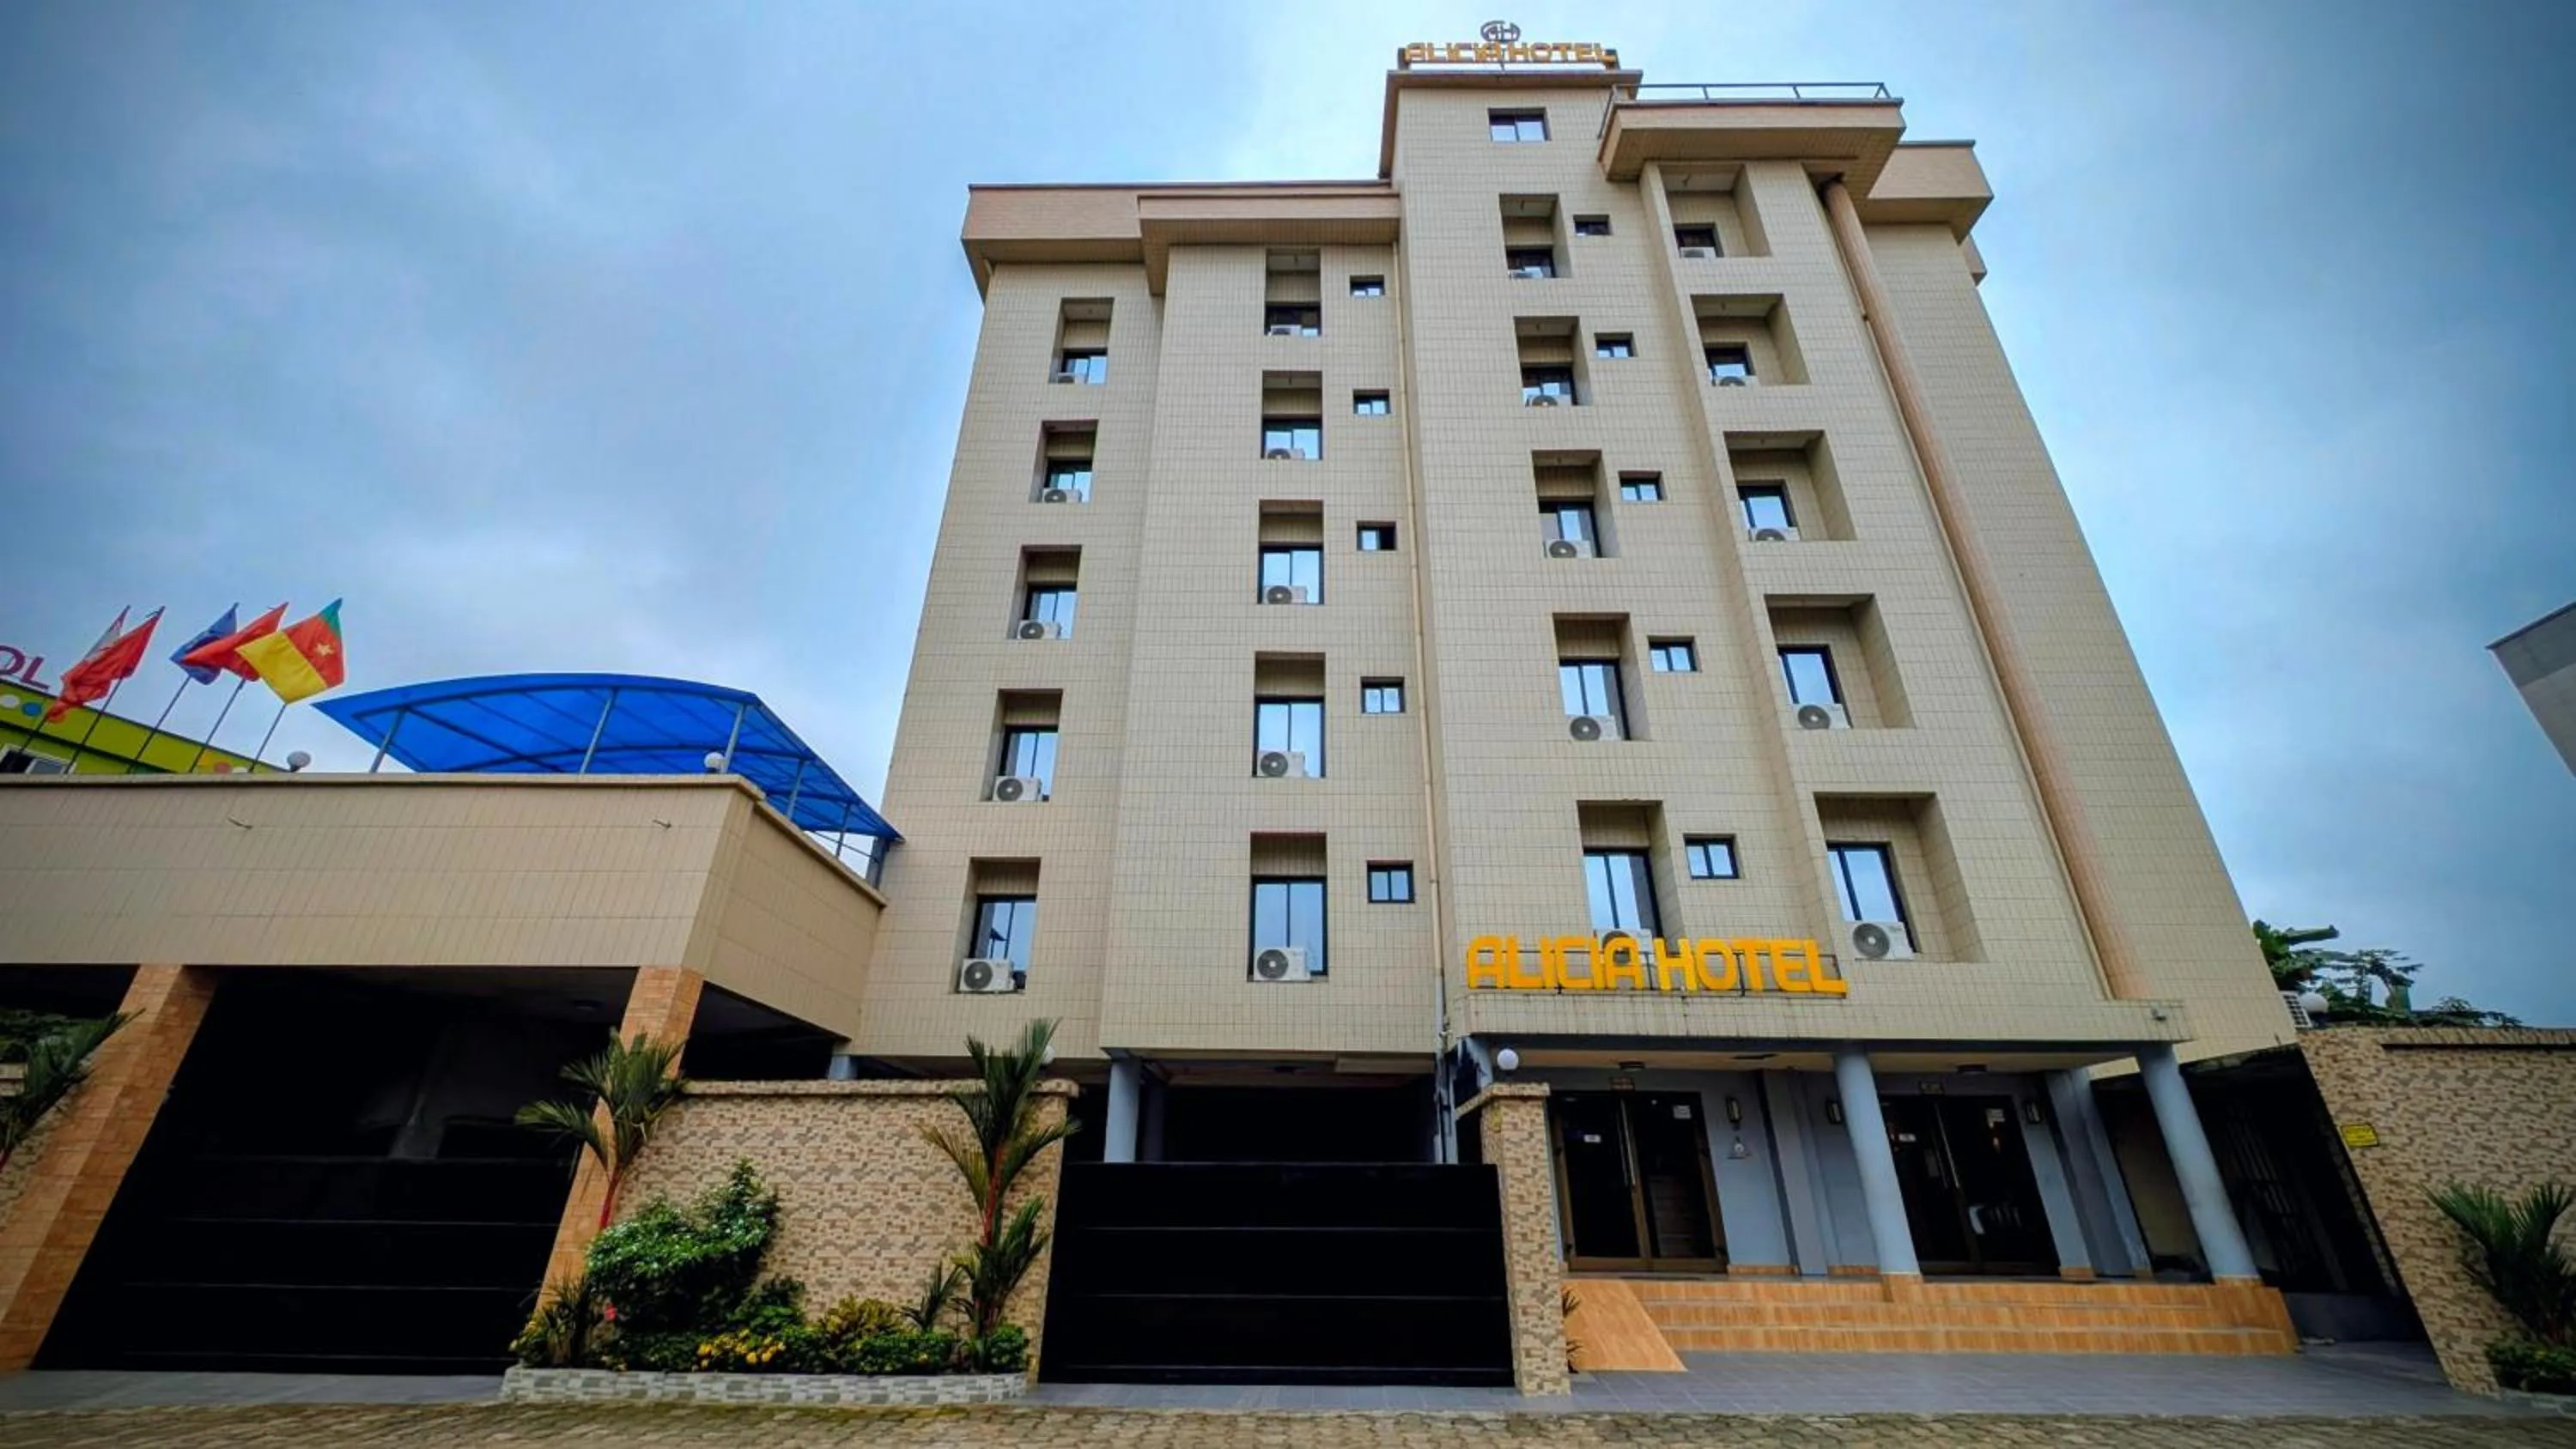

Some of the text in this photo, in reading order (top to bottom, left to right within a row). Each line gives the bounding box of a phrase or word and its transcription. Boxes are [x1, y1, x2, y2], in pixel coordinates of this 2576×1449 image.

[1405, 42, 1617, 62] ALICIA HOTEL
[1467, 934, 1847, 994] ALICIA HOTEL
